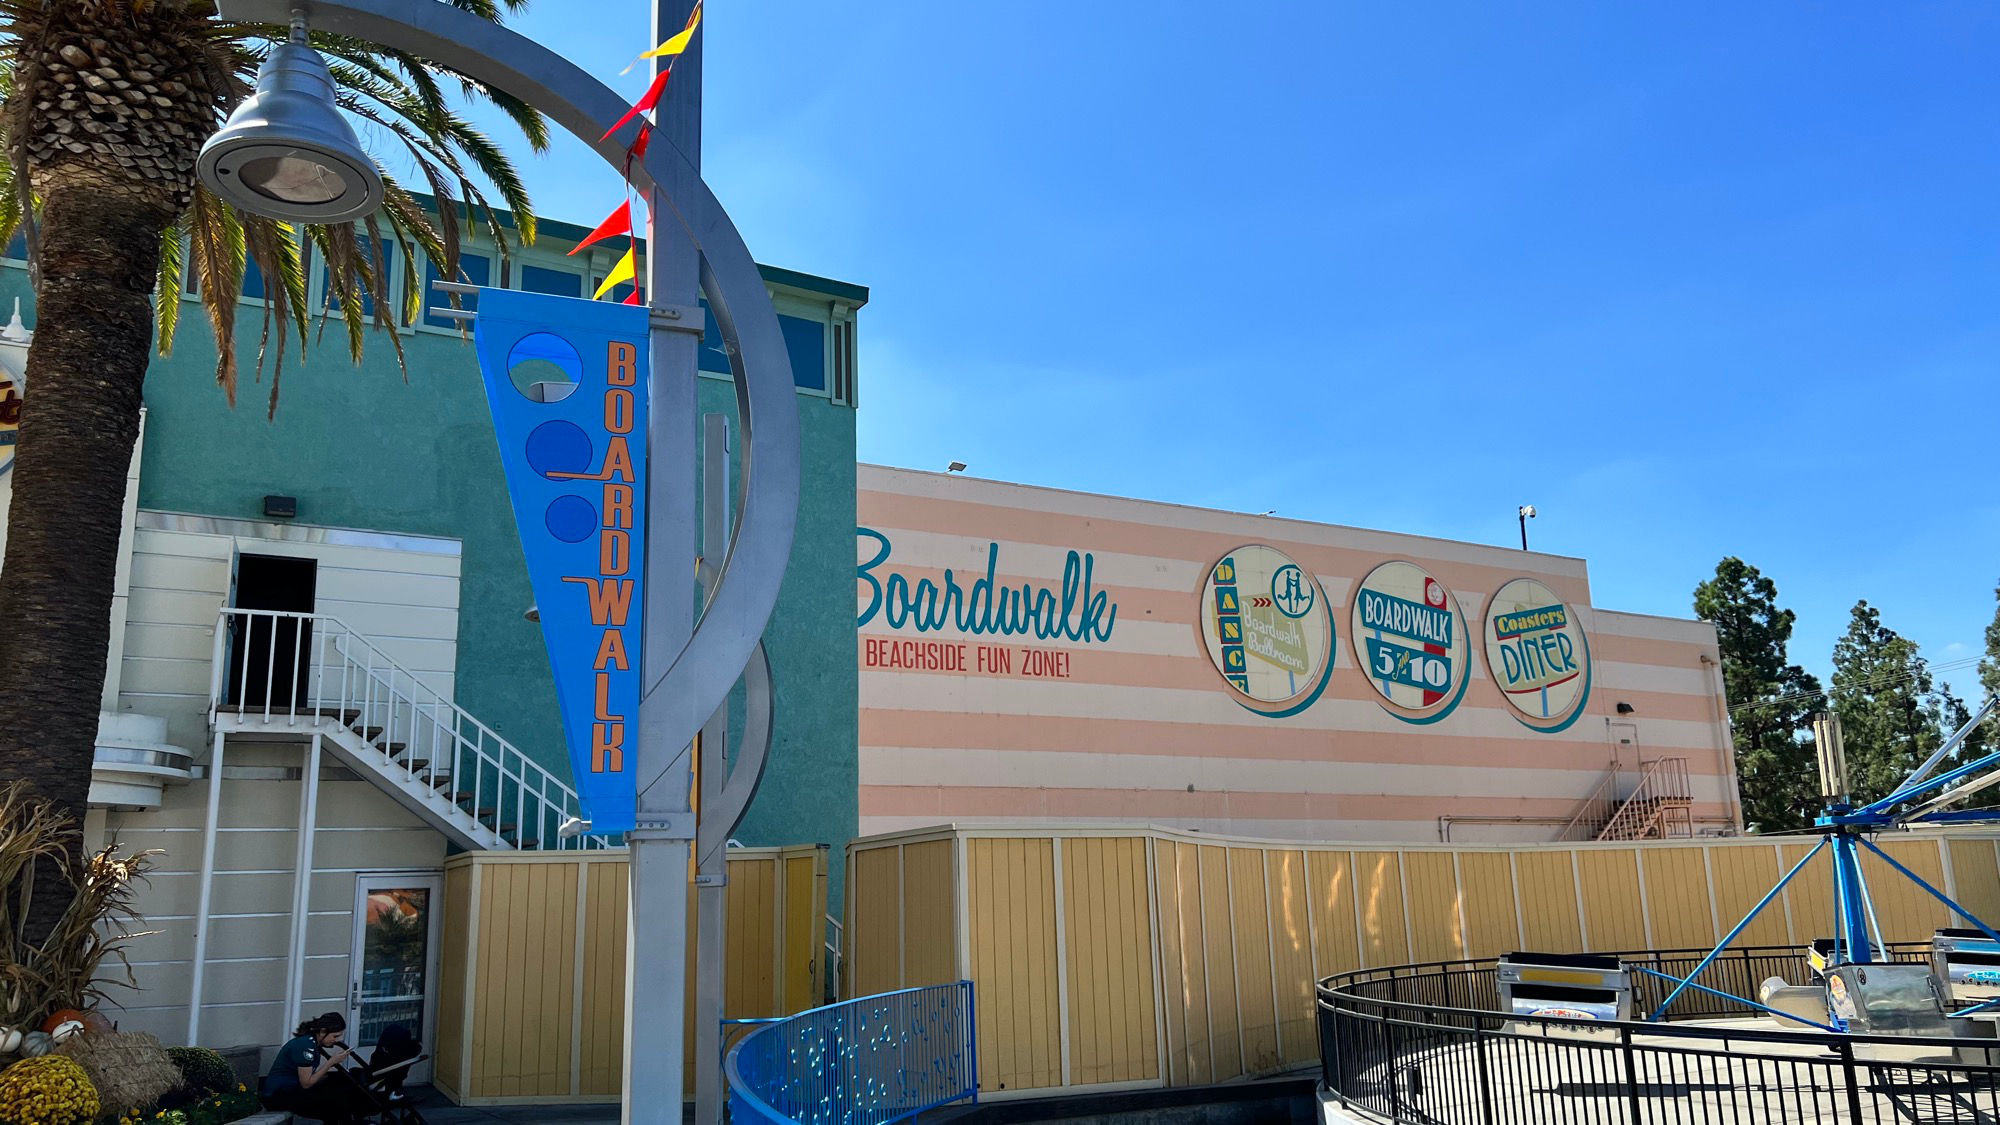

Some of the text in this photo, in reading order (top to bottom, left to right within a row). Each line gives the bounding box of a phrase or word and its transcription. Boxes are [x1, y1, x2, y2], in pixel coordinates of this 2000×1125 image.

[546, 341, 636, 773] BOARDWALK
[857, 526, 1117, 643] Boardwalk
[1365, 593, 1448, 644] BOARDWALK
[1497, 608, 1565, 633] Coasters
[865, 638, 1070, 678] BEACHSIDE FUN ZONE!
[1376, 646, 1395, 675] 5
[1409, 656, 1447, 687] 10
[1500, 632, 1578, 687] DINER
